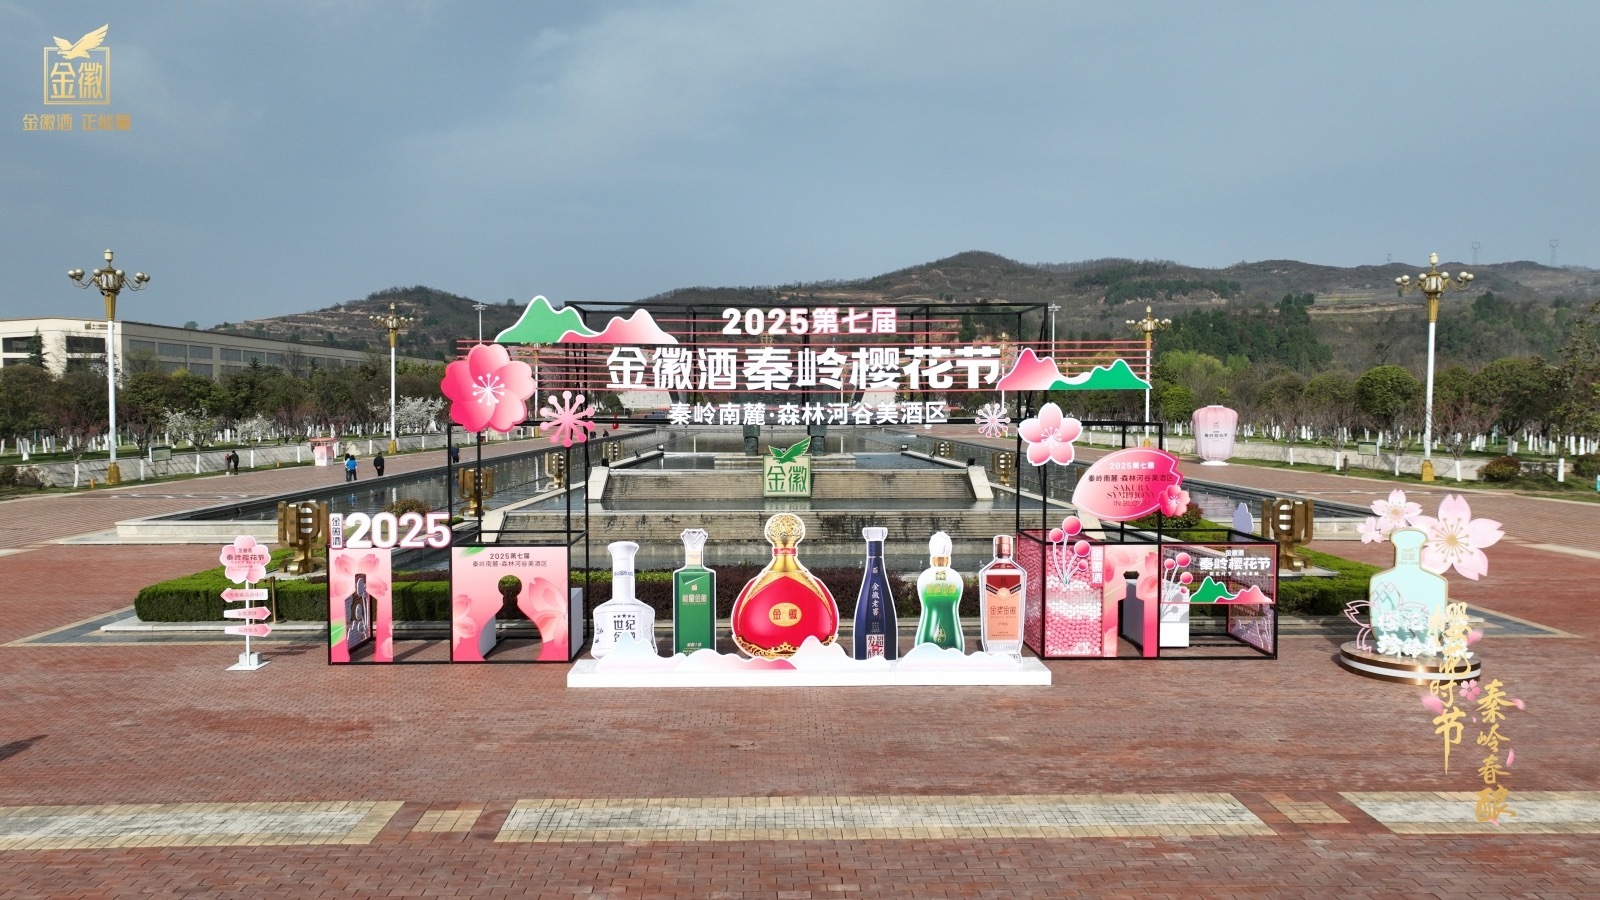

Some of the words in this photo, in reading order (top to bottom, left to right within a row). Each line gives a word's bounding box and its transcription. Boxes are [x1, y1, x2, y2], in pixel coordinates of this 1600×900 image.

[722, 307, 897, 335] 2025第七届
[606, 346, 1001, 391] 金徽酒秦岭樱花节
[668, 401, 948, 426] 秦岭南麓·森林河谷美酒区
[767, 465, 807, 492] 金徽
[345, 512, 452, 549] 2025
[1199, 557, 1271, 570] 秦岭樱花节
[613, 619, 636, 631] 世纪
